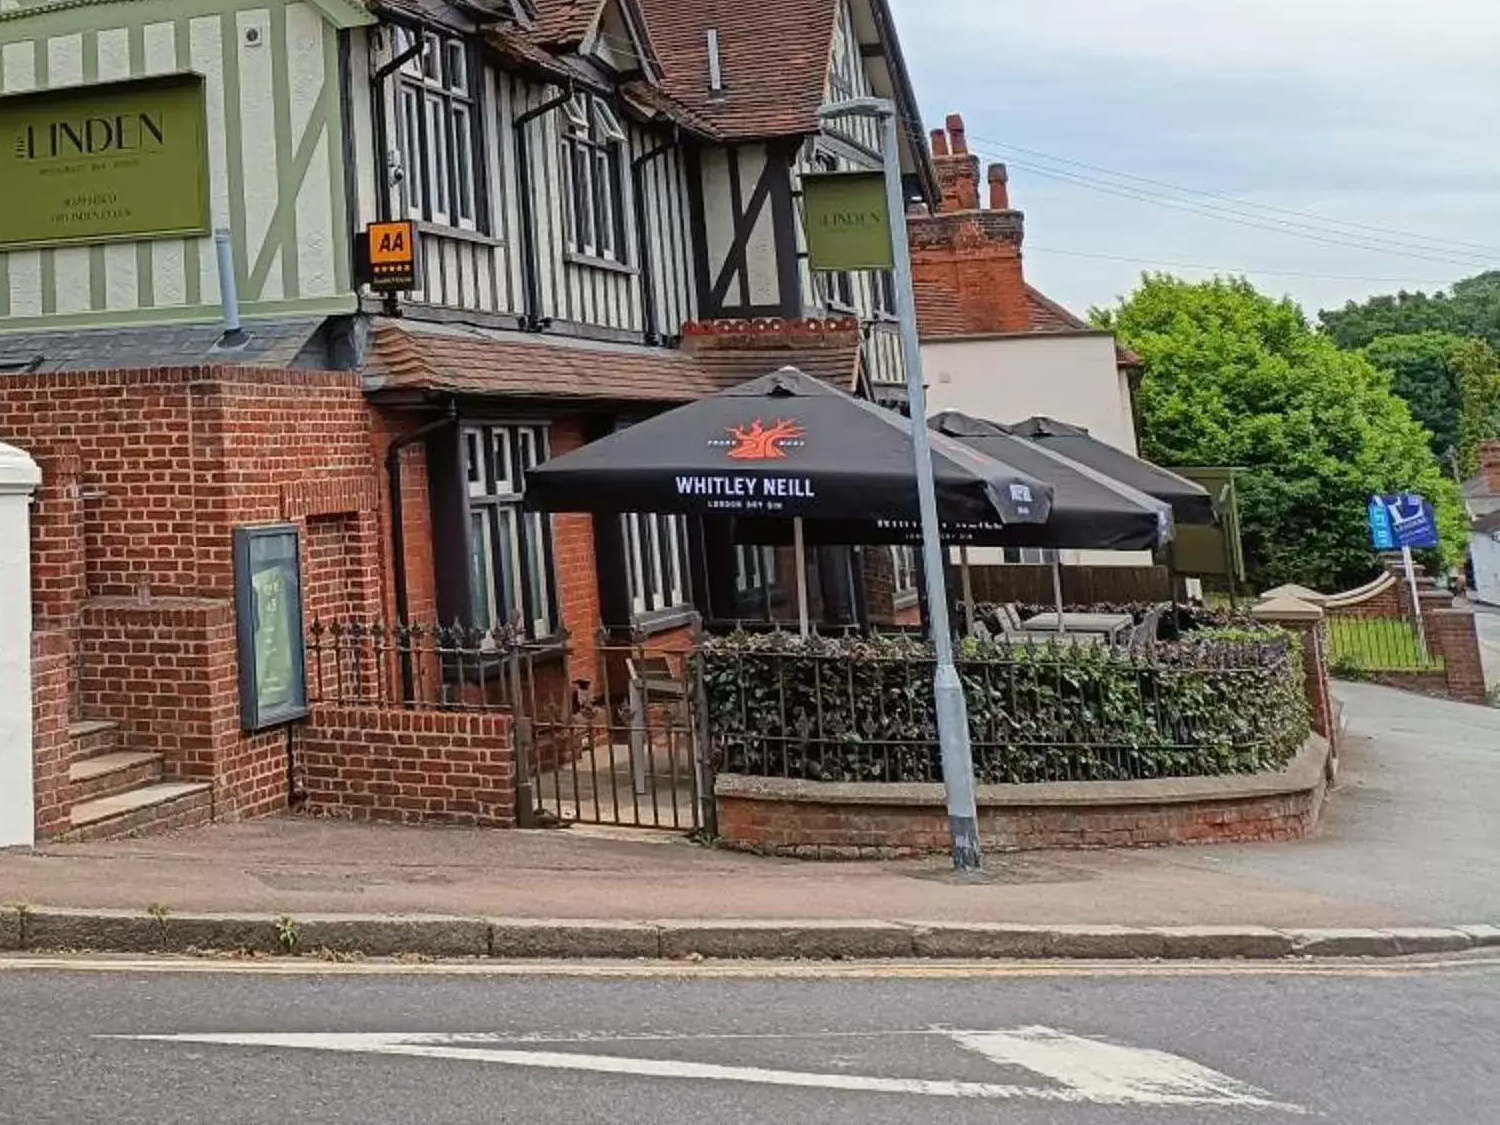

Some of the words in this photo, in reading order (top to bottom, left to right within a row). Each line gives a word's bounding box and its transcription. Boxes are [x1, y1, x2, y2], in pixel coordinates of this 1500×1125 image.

[27, 111, 163, 160] LINDEN
[378, 230, 404, 252] AA
[675, 476, 758, 496] WHITLEY
[763, 477, 816, 497] NEILL
